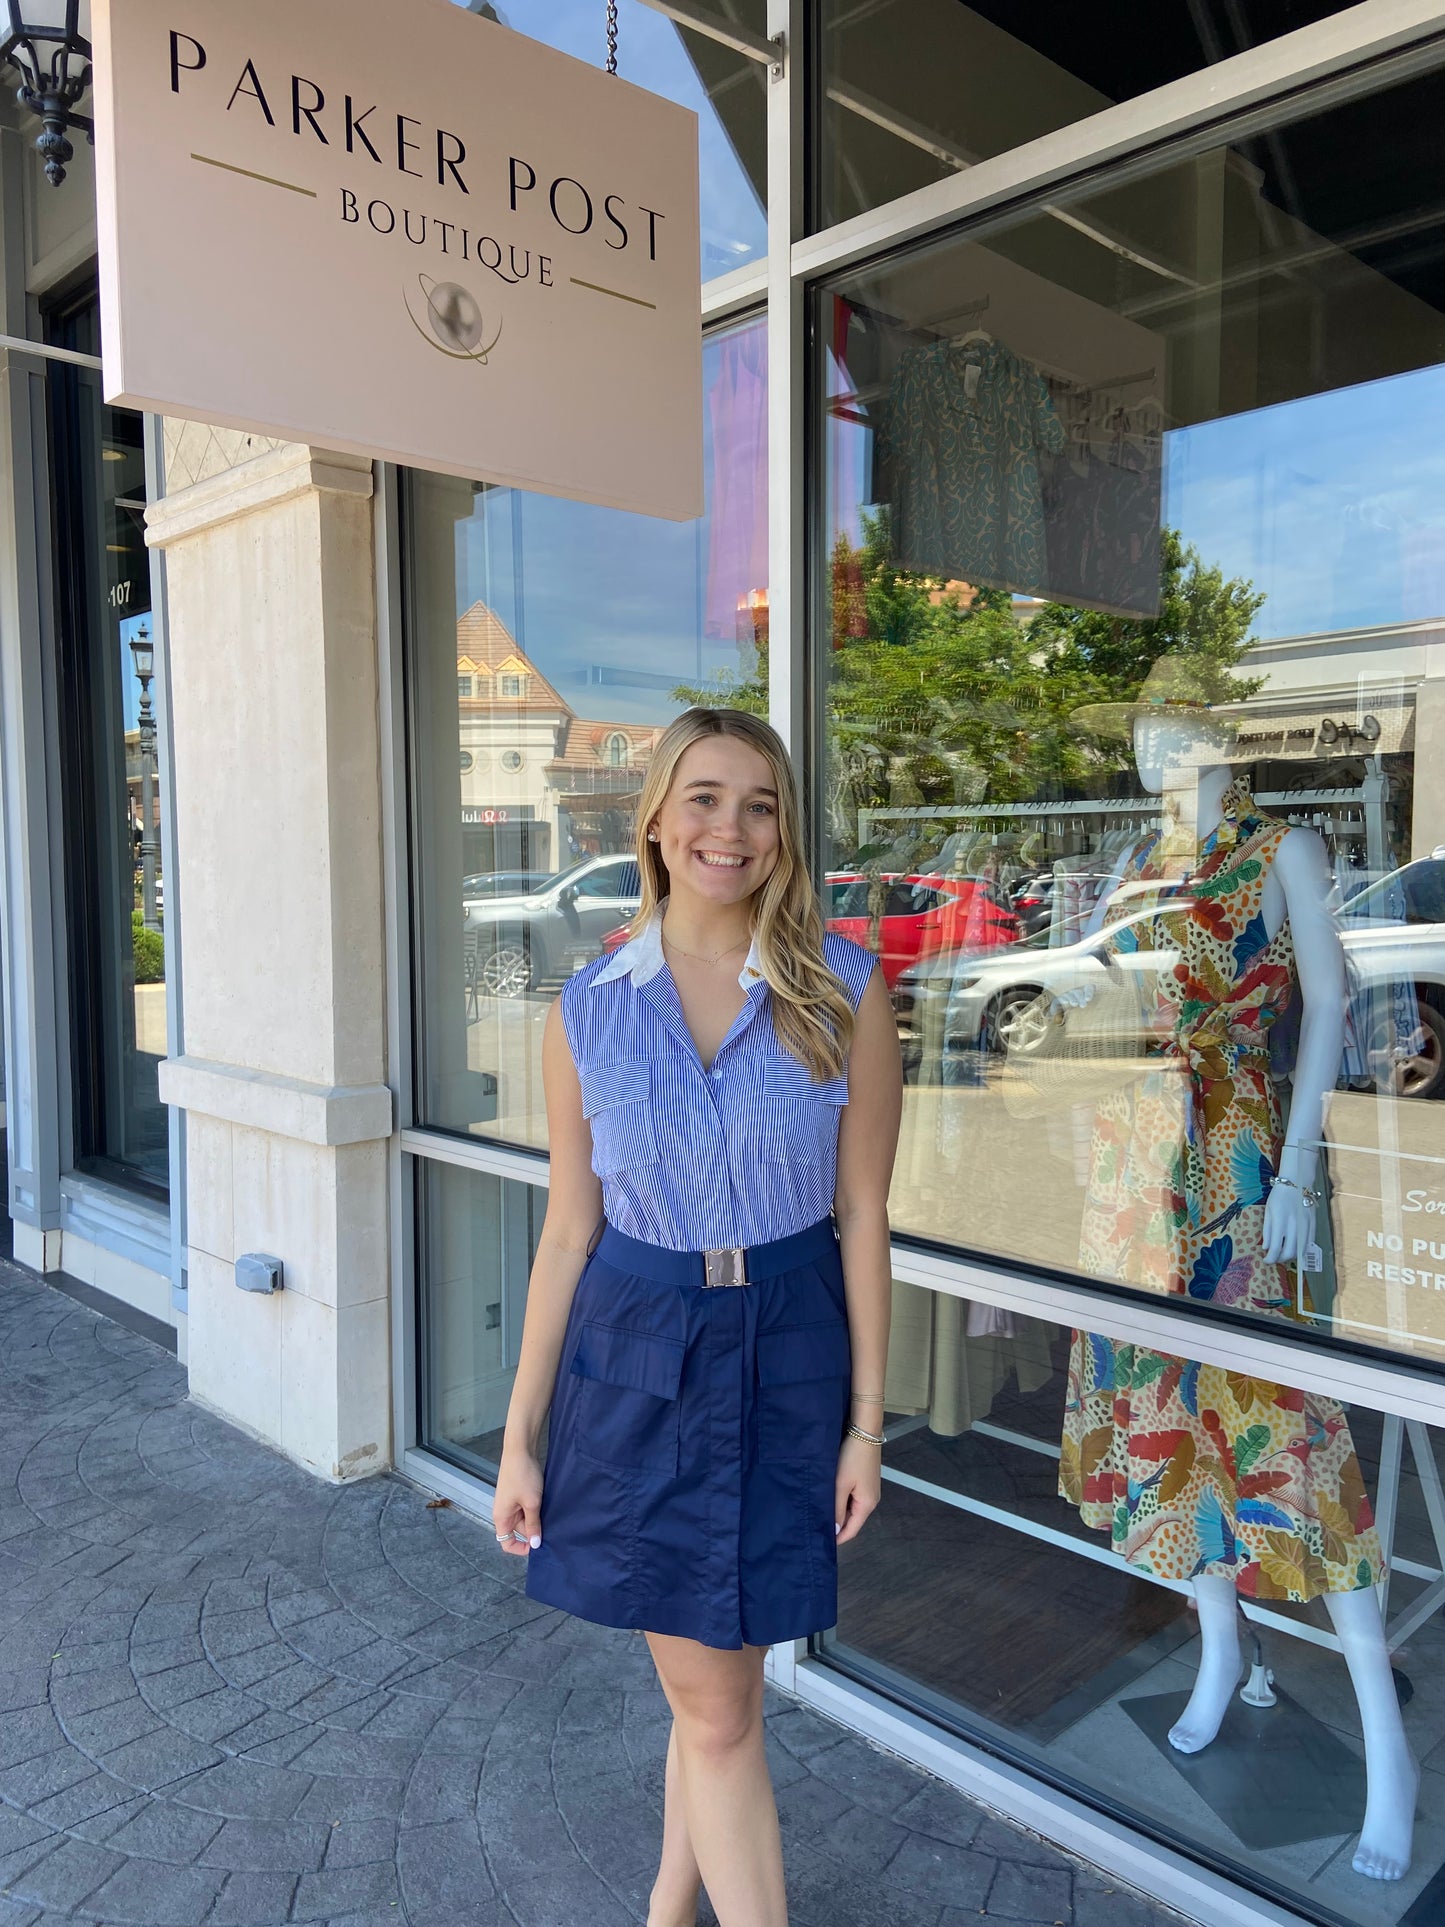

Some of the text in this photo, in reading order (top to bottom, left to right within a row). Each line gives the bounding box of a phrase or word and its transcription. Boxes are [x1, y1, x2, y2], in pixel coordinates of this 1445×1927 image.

[169, 29, 666, 261] PARKER POST
[339, 187, 554, 288] BOUTIQUE
[1367, 1230, 1445, 1260] NO PU
[1367, 1260, 1445, 1291] RESTR
